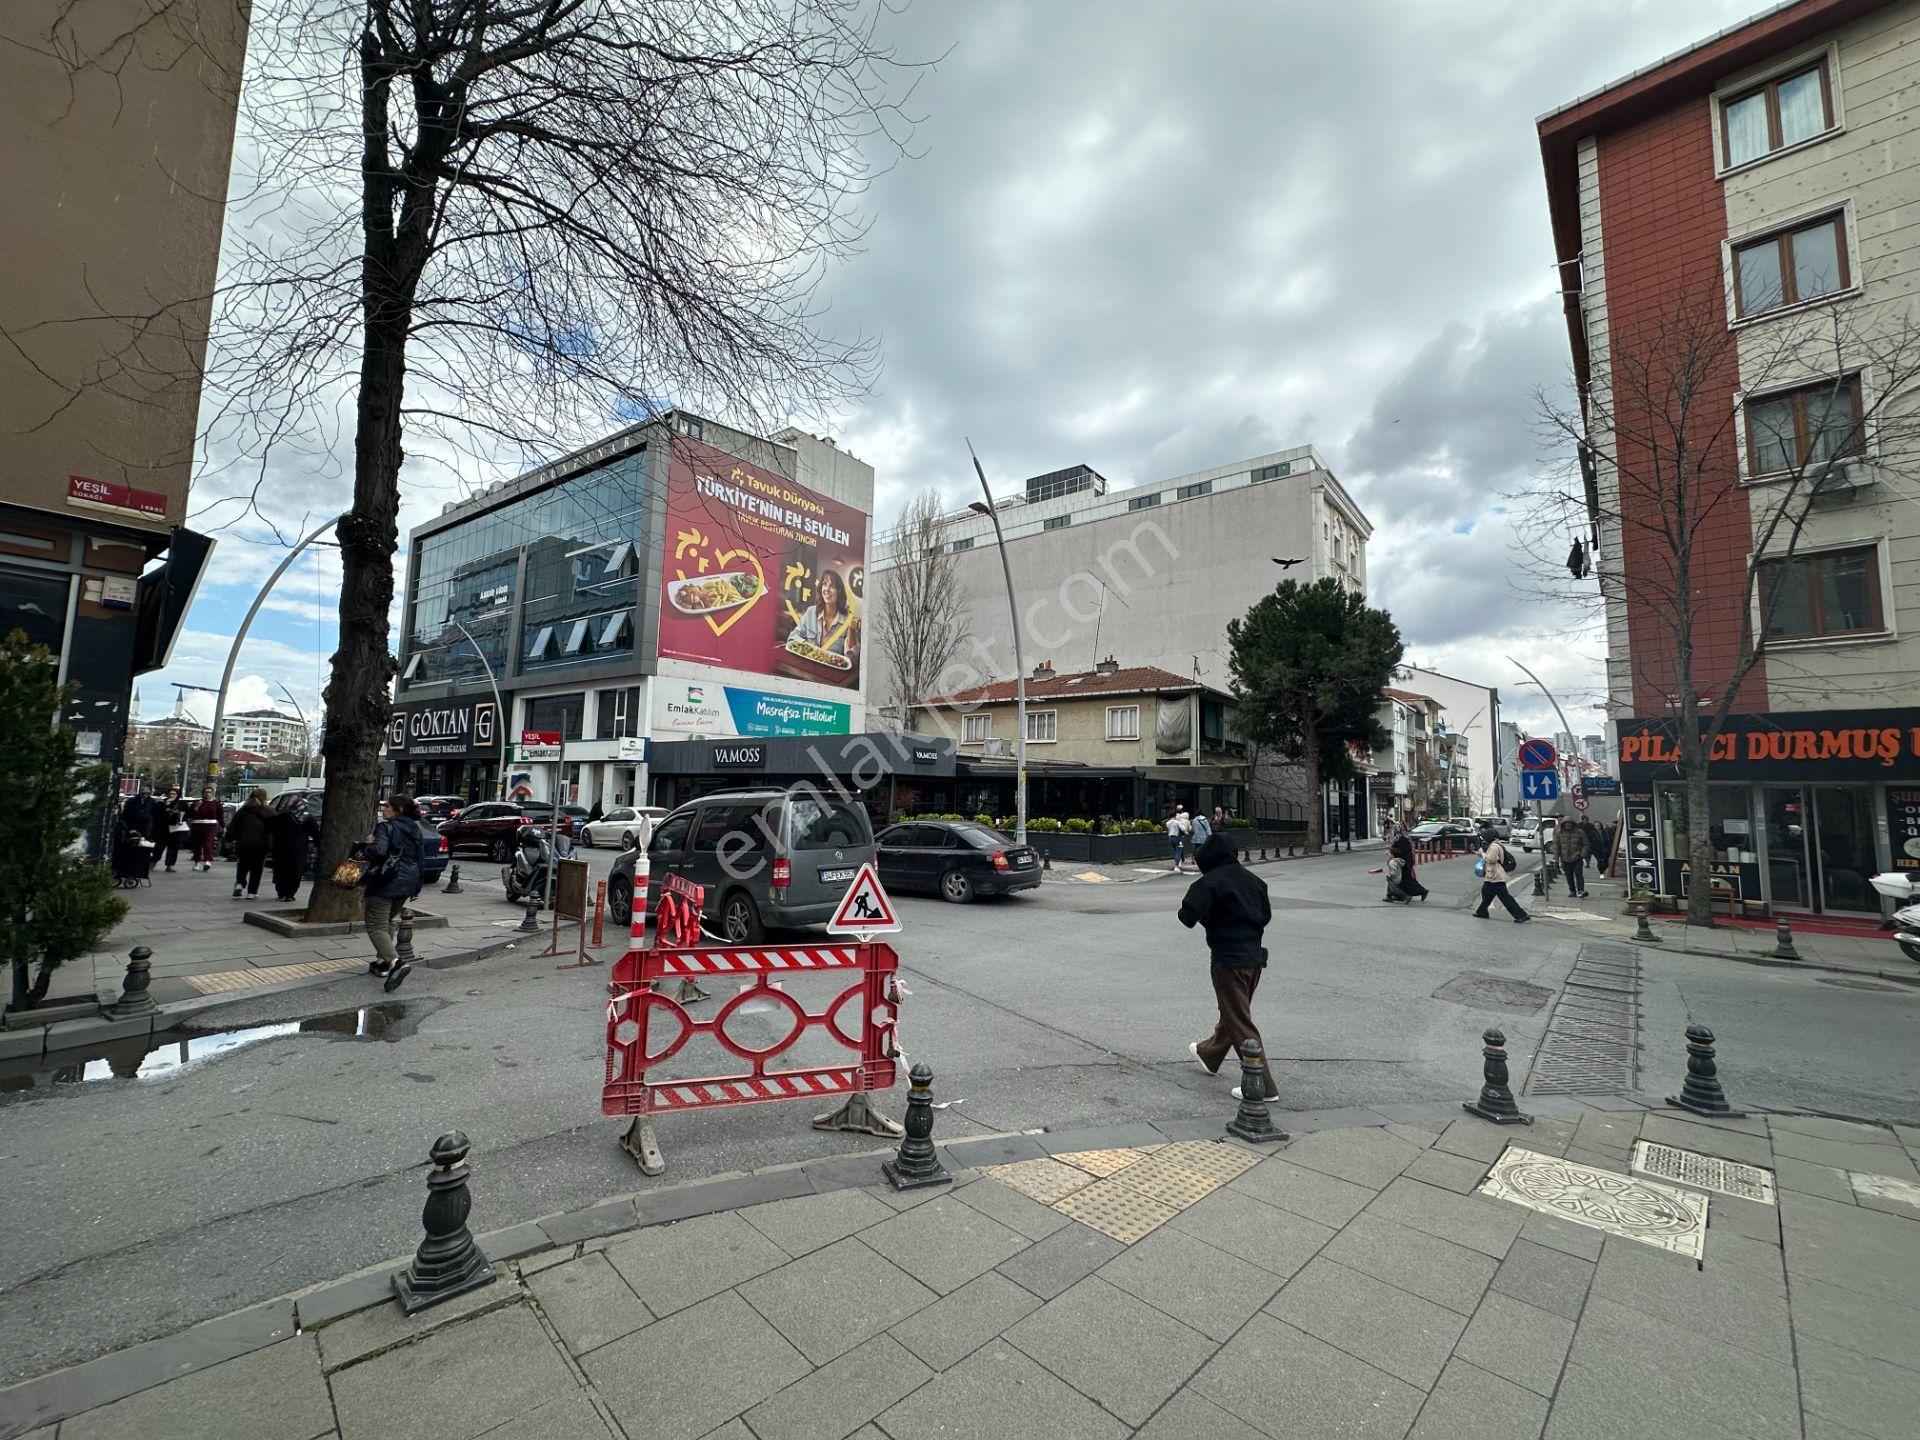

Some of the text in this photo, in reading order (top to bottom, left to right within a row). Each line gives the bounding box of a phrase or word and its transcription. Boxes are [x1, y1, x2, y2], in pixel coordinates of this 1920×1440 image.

[74, 479, 111, 495] YEŞİL
[747, 475, 824, 516] Tavuk Dünyası
[695, 474, 850, 547] TÜRKİYE'NİN EN SEVİLEN
[410, 707, 470, 737] GÖKTAN
[667, 703, 720, 717] EmlakKatılım
[756, 701, 801, 722] Masrafsız
[802, 709, 837, 724] Hallolur!
[714, 748, 760, 763] VAMOSS
[1747, 727, 1900, 766] DURMUŞ
